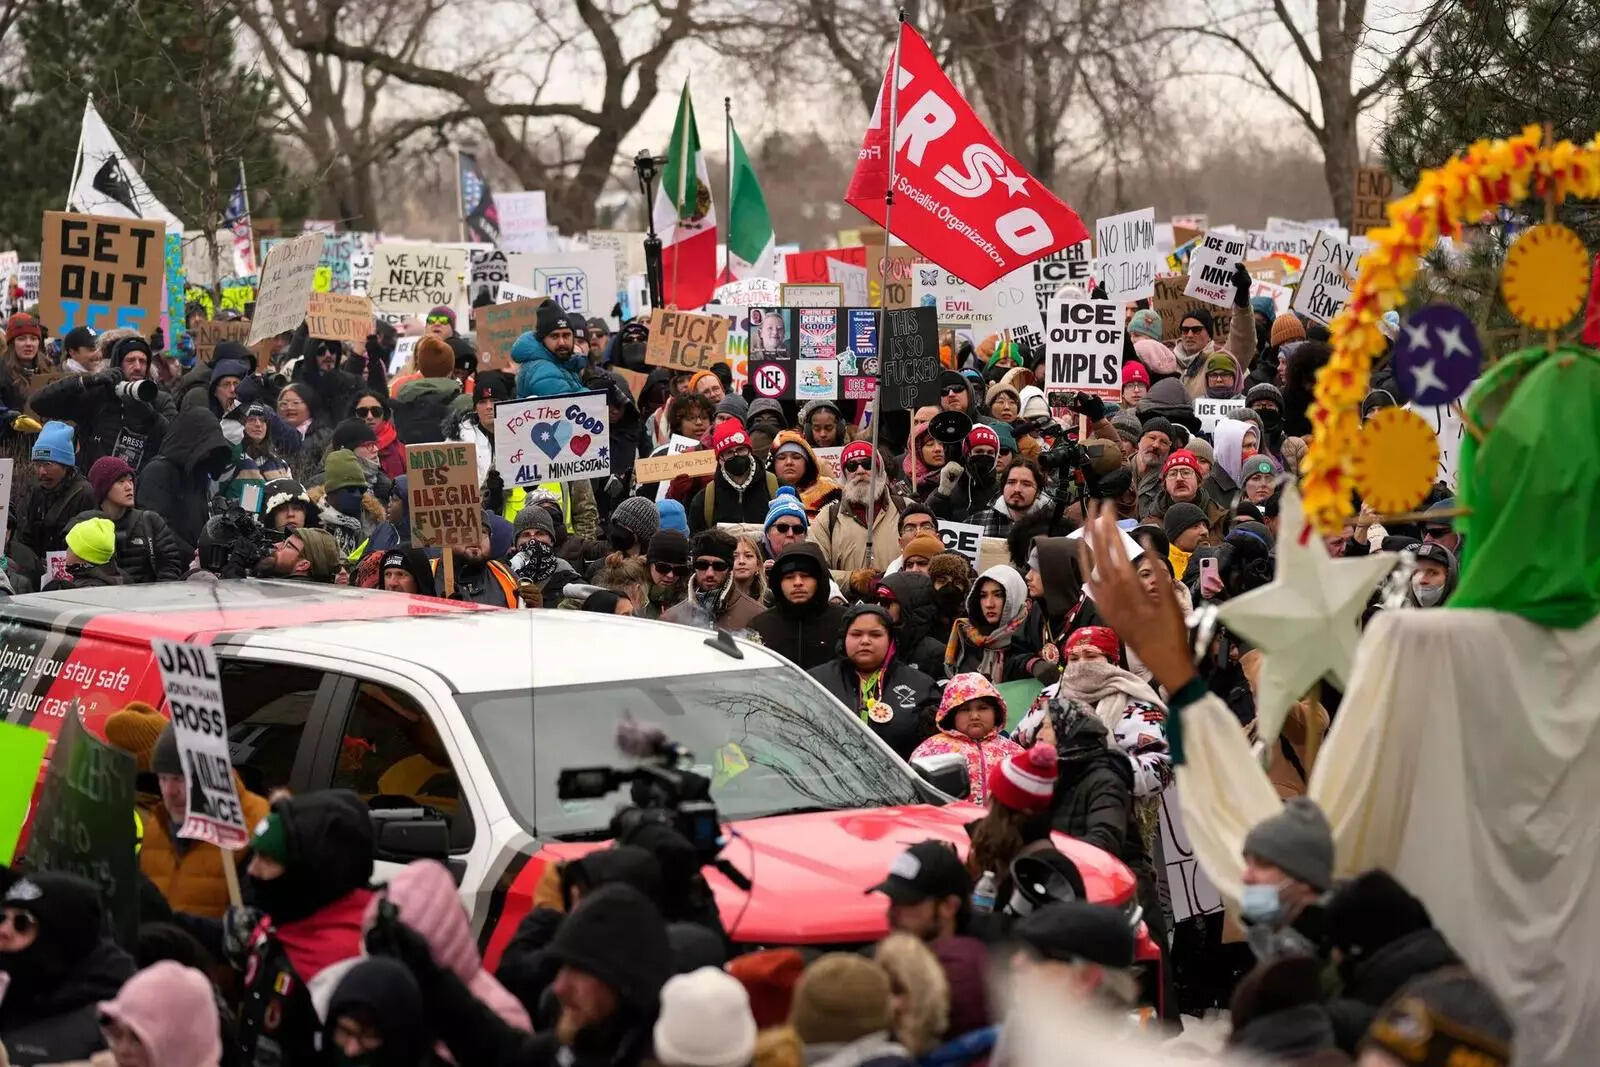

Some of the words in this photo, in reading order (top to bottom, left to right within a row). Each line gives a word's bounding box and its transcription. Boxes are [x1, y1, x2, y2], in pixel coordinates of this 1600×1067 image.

[899, 177, 940, 214] Socialist
[937, 206, 1007, 268] Organization
[60, 219, 155, 269] GET
[1099, 224, 1119, 257] NO
[1123, 217, 1155, 254] HUMAN
[1204, 235, 1224, 252] ICE
[1224, 241, 1245, 257] OUT
[385, 253, 408, 268] WE
[416, 255, 452, 270] WILL
[1215, 256, 1228, 266] OF
[1318, 238, 1354, 271] SAY
[388, 269, 446, 288] NEVER
[1033, 261, 1090, 282] ICE
[1200, 264, 1234, 288] MN!
[60, 265, 148, 305] OUT
[380, 287, 420, 304] FEAR
[423, 290, 453, 305] YOU
[748, 279, 768, 291] USE
[885, 282, 906, 305] TO
[945, 301, 974, 312] EVIL
[1060, 303, 1117, 325] ICE
[660, 312, 722, 345] FUCK
[802, 315, 834, 324] RENEE
[888, 310, 919, 337] THIS
[1012, 325, 1029, 337] FOR
[889, 337, 904, 360] IS
[905, 334, 924, 357] SO
[1050, 328, 1091, 344] OUT
[1094, 330, 1122, 345] OF
[668, 339, 714, 371] ICE
[761, 370, 781, 390] ICE
[884, 356, 939, 387] FUCKED
[1051, 352, 1119, 385] MPLS
[900, 384, 919, 409] UP
[506, 409, 536, 435] FOR
[536, 406, 561, 419] The
[565, 404, 605, 435] GOOD
[1198, 403, 1217, 415] ICE
[121, 435, 145, 449] PRESS
[409, 446, 468, 470] NADIE
[509, 448, 524, 464] of
[422, 464, 450, 486] ES
[514, 464, 543, 485] ALL
[548, 456, 610, 479] MINNESOTANS
[412, 484, 480, 507] ILEGAL
[414, 506, 479, 531] FUERA
[940, 528, 979, 552] CE
[33, 657, 64, 679] you
[63, 660, 97, 690] stay
[96, 666, 131, 692] safe
[159, 644, 217, 681] JAIL
[6, 691, 44, 713] your
[171, 700, 224, 738] ROSS
